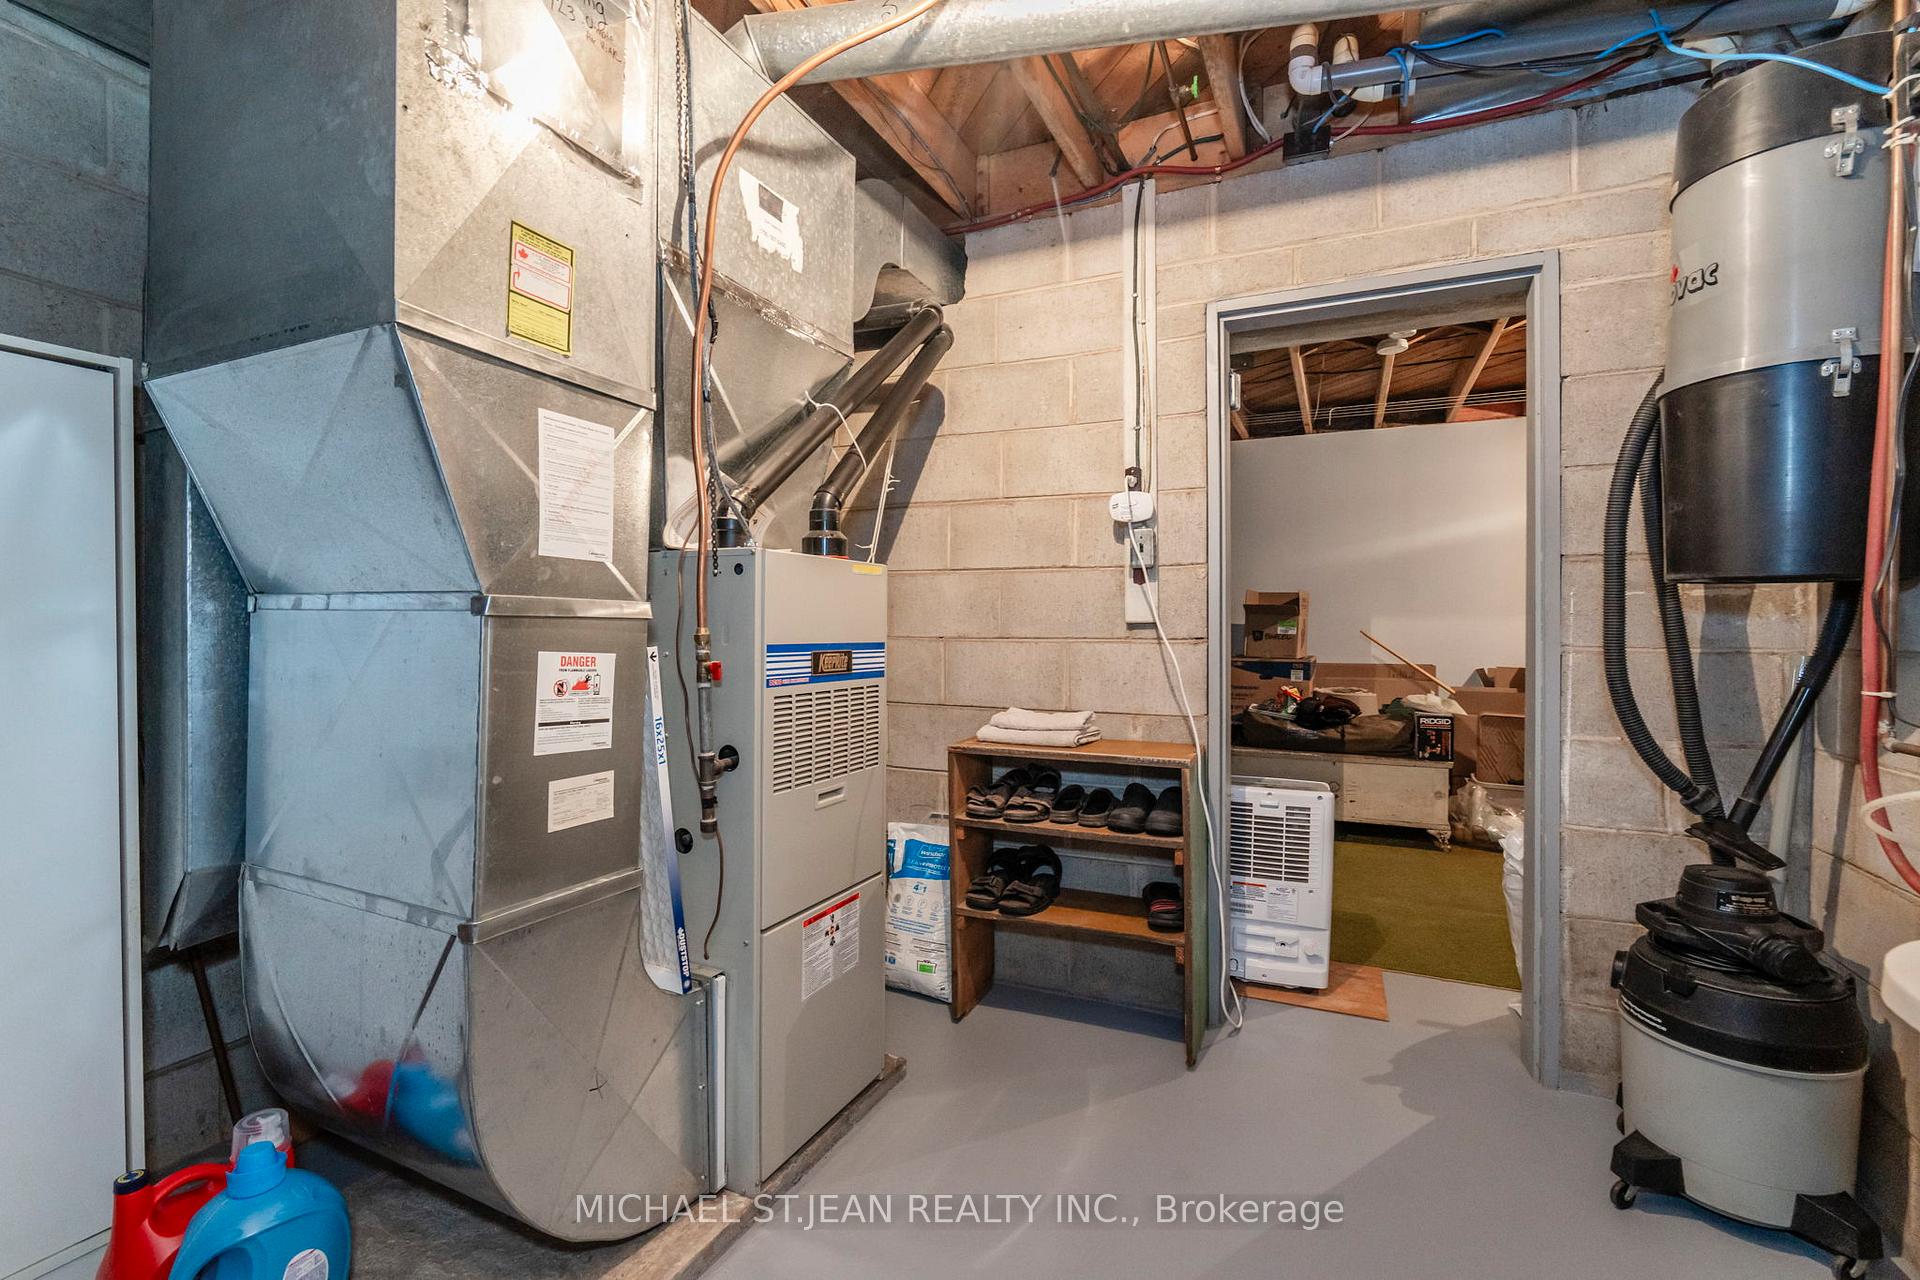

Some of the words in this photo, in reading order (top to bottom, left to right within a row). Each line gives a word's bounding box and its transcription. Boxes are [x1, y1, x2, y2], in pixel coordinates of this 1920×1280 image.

[560, 655, 597, 668] DANGER
[1420, 717, 1452, 725] RIDGID
[654, 716, 666, 765] 16x25x1
